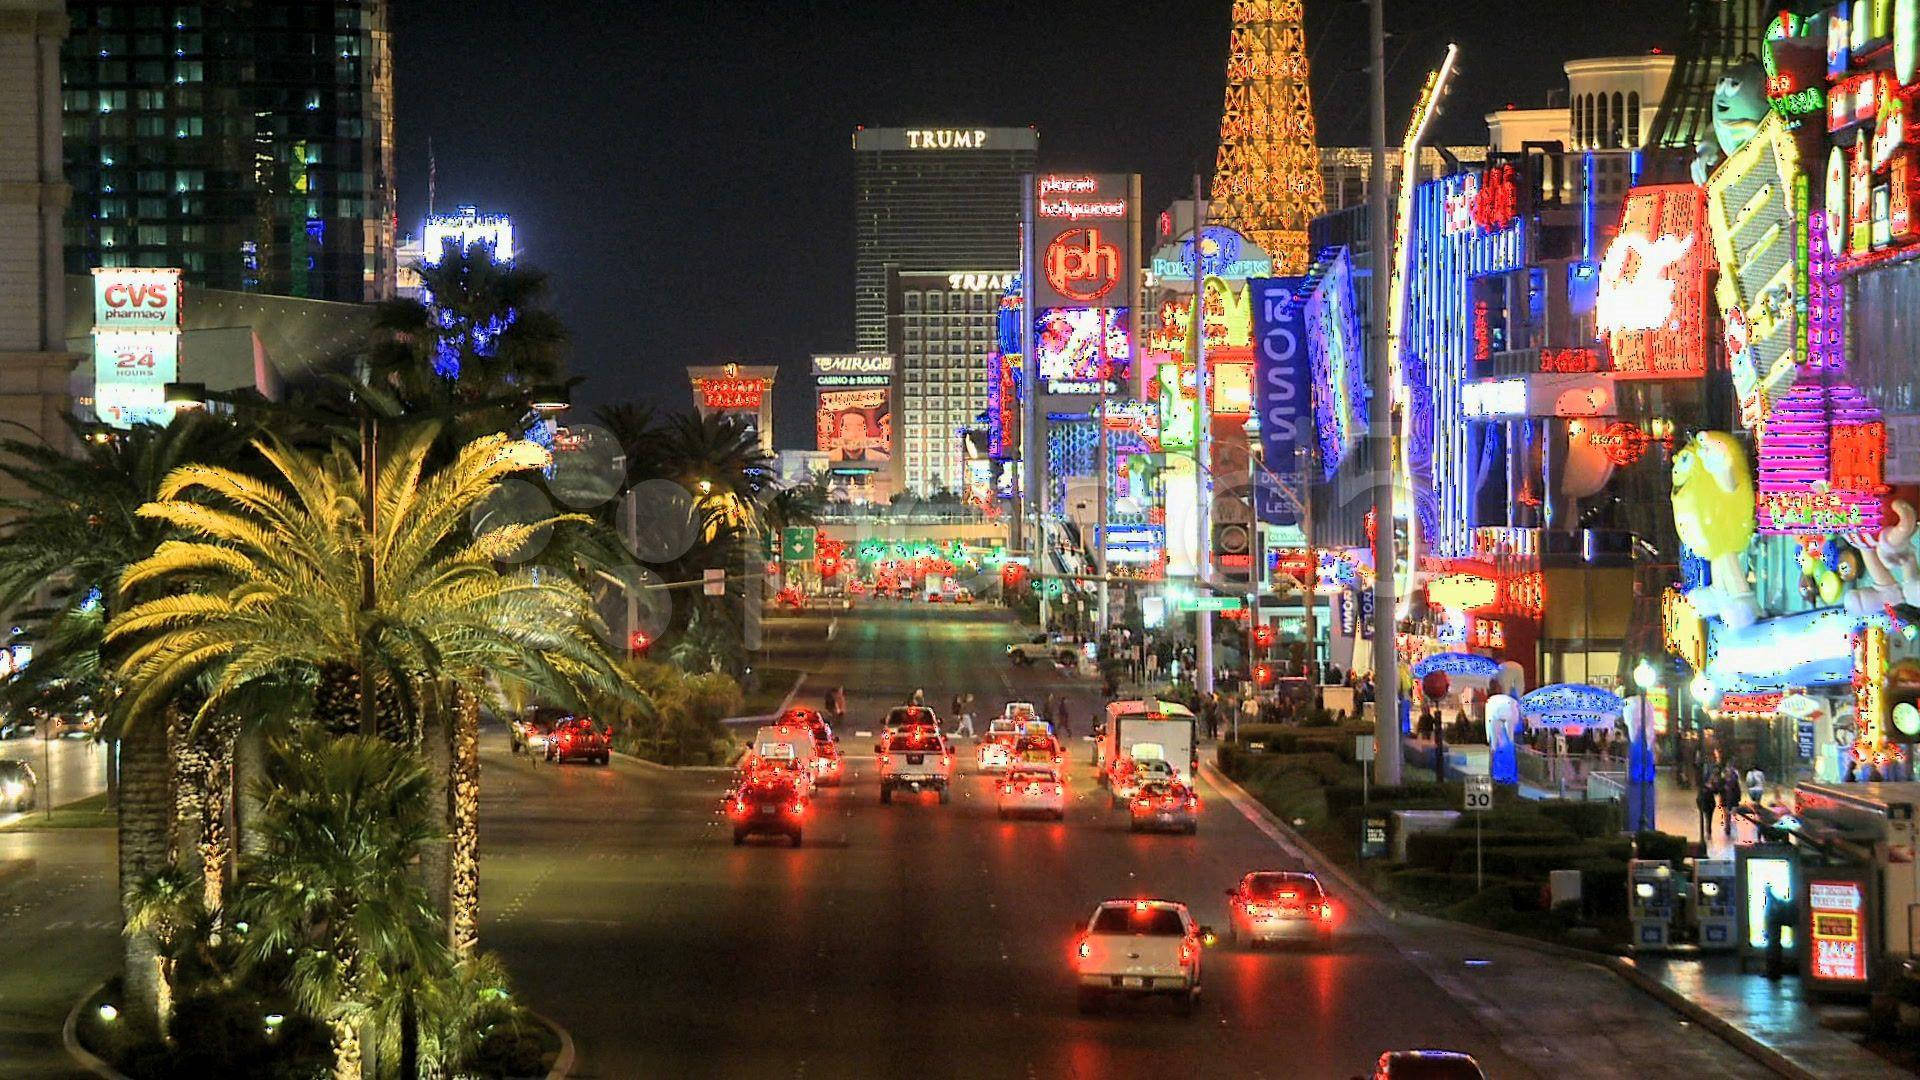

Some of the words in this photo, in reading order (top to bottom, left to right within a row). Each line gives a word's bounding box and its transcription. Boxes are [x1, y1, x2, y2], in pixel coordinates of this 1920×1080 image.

[906, 130, 986, 149] TRUMP
[1040, 198, 1125, 219] hollywood
[104, 284, 168, 309] CVS
[105, 310, 166, 321] pharmacy
[117, 353, 155, 368] 24
[830, 357, 892, 371] MIRAGE
[1263, 288, 1298, 441] ROSS
[817, 376, 848, 385] CASINO
[849, 376, 856, 385] &
[857, 376, 889, 385] RESORT
[1261, 472, 1304, 484] DRESS
[1270, 487, 1298, 500] FOR
[1266, 502, 1300, 513] LESS
[1343, 590, 1353, 633] ROSS
[1467, 793, 1489, 806] 30
